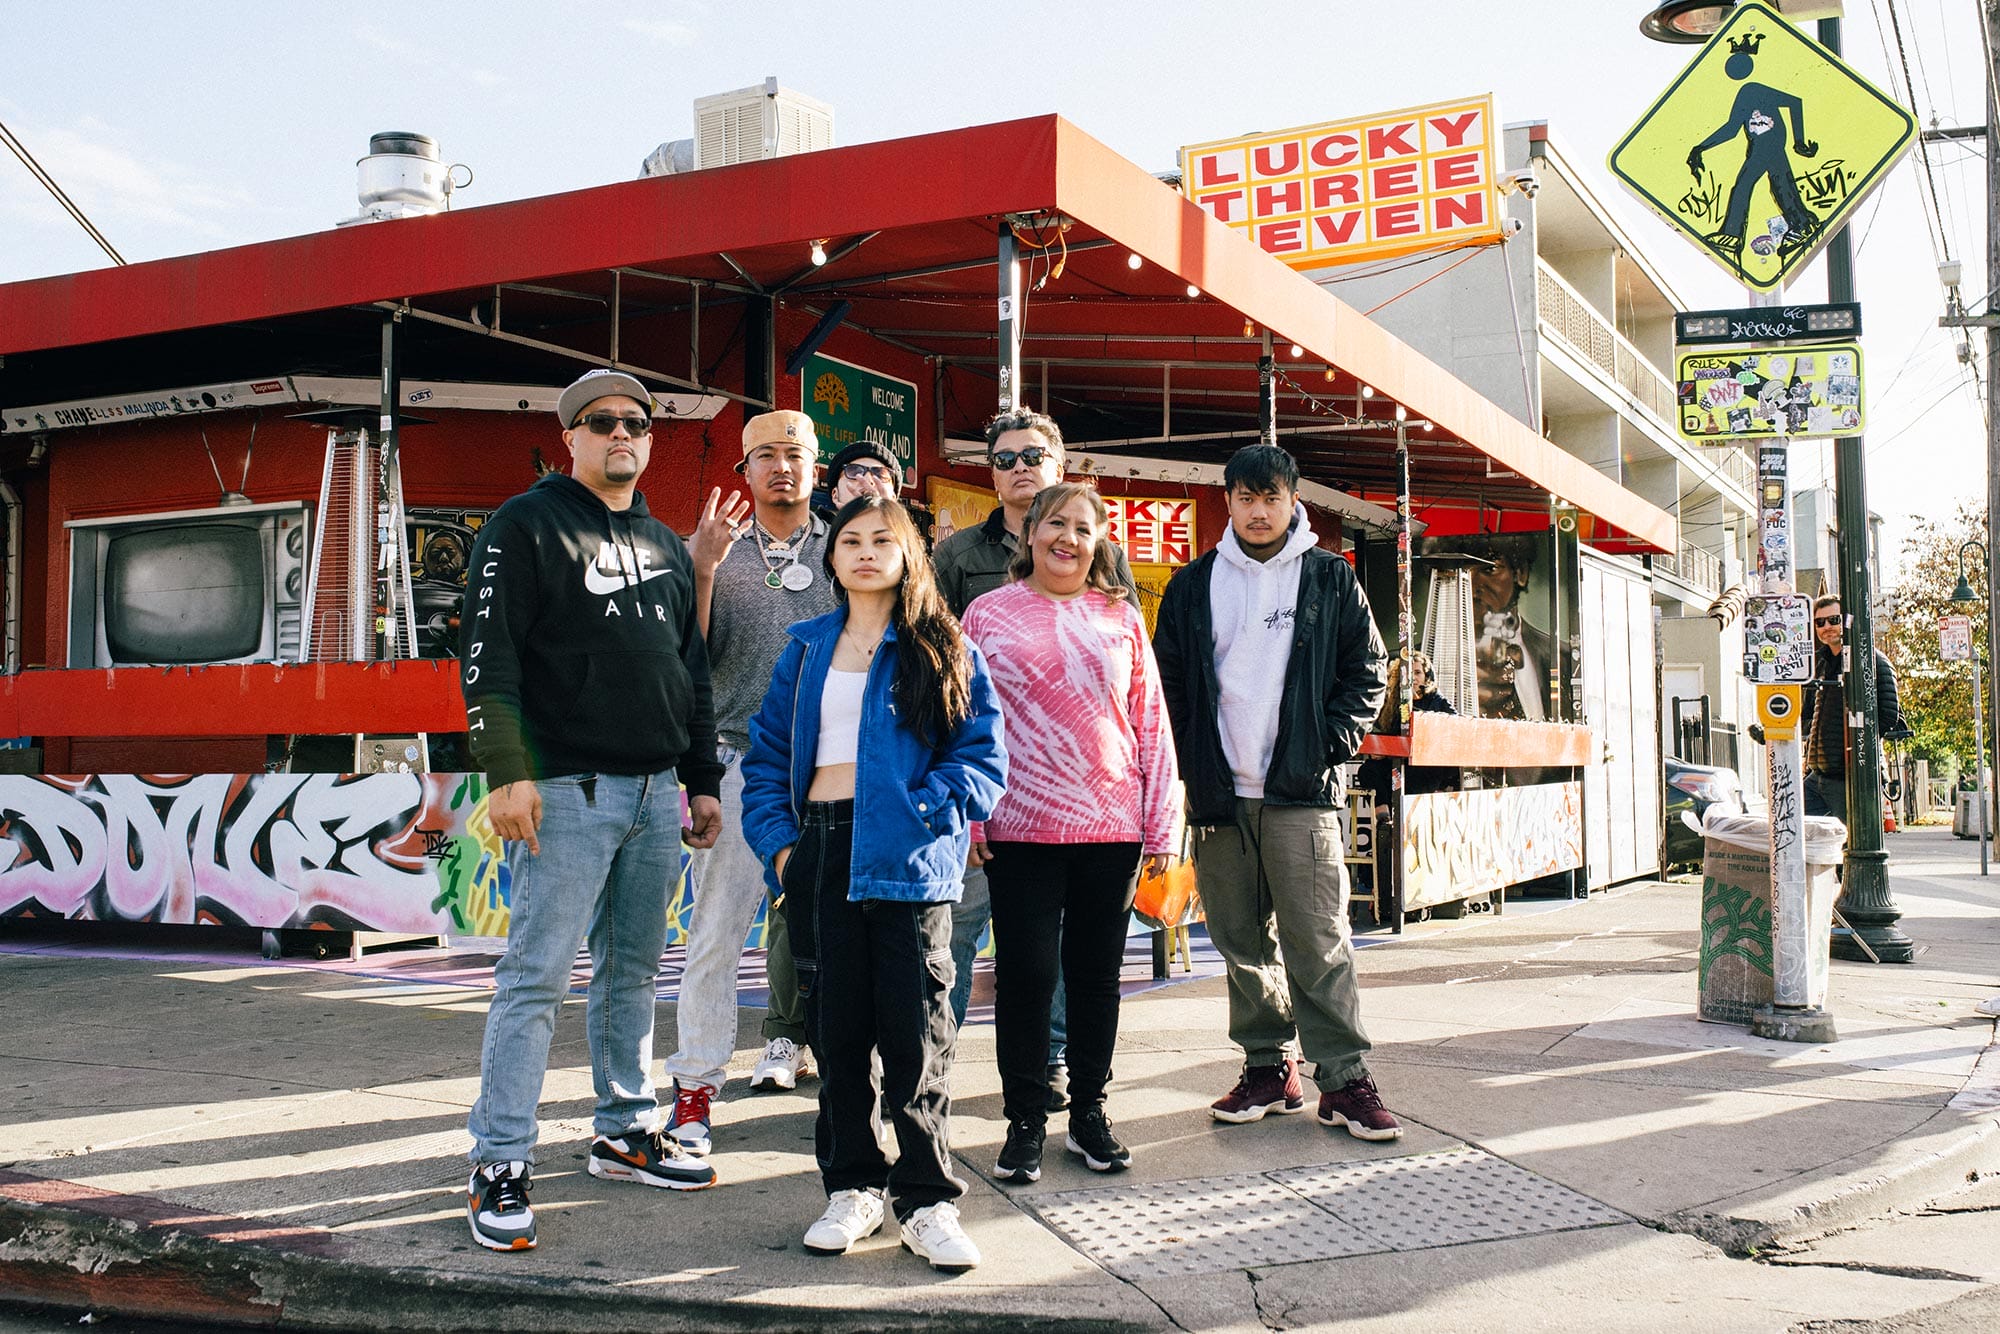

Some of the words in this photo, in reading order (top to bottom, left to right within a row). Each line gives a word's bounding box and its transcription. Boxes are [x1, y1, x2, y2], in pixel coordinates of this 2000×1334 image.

[1201, 111, 1480, 187] LUCKY
[1200, 153, 1481, 223] THREE
[1259, 192, 1484, 253] EVEN
[252, 383, 281, 393] Supreme
[871, 386, 905, 413] WELCOME
[123, 400, 171, 415] MALINDA
[885, 413, 893, 426] TO
[814, 421, 831, 439] OVE
[834, 427, 857, 445] LIFE!
[865, 425, 911, 460] OAKLAND
[598, 541, 651, 575] NIKE
[477, 545, 502, 618] JUST
[605, 598, 666, 622] AIR
[466, 642, 483, 685] DO
